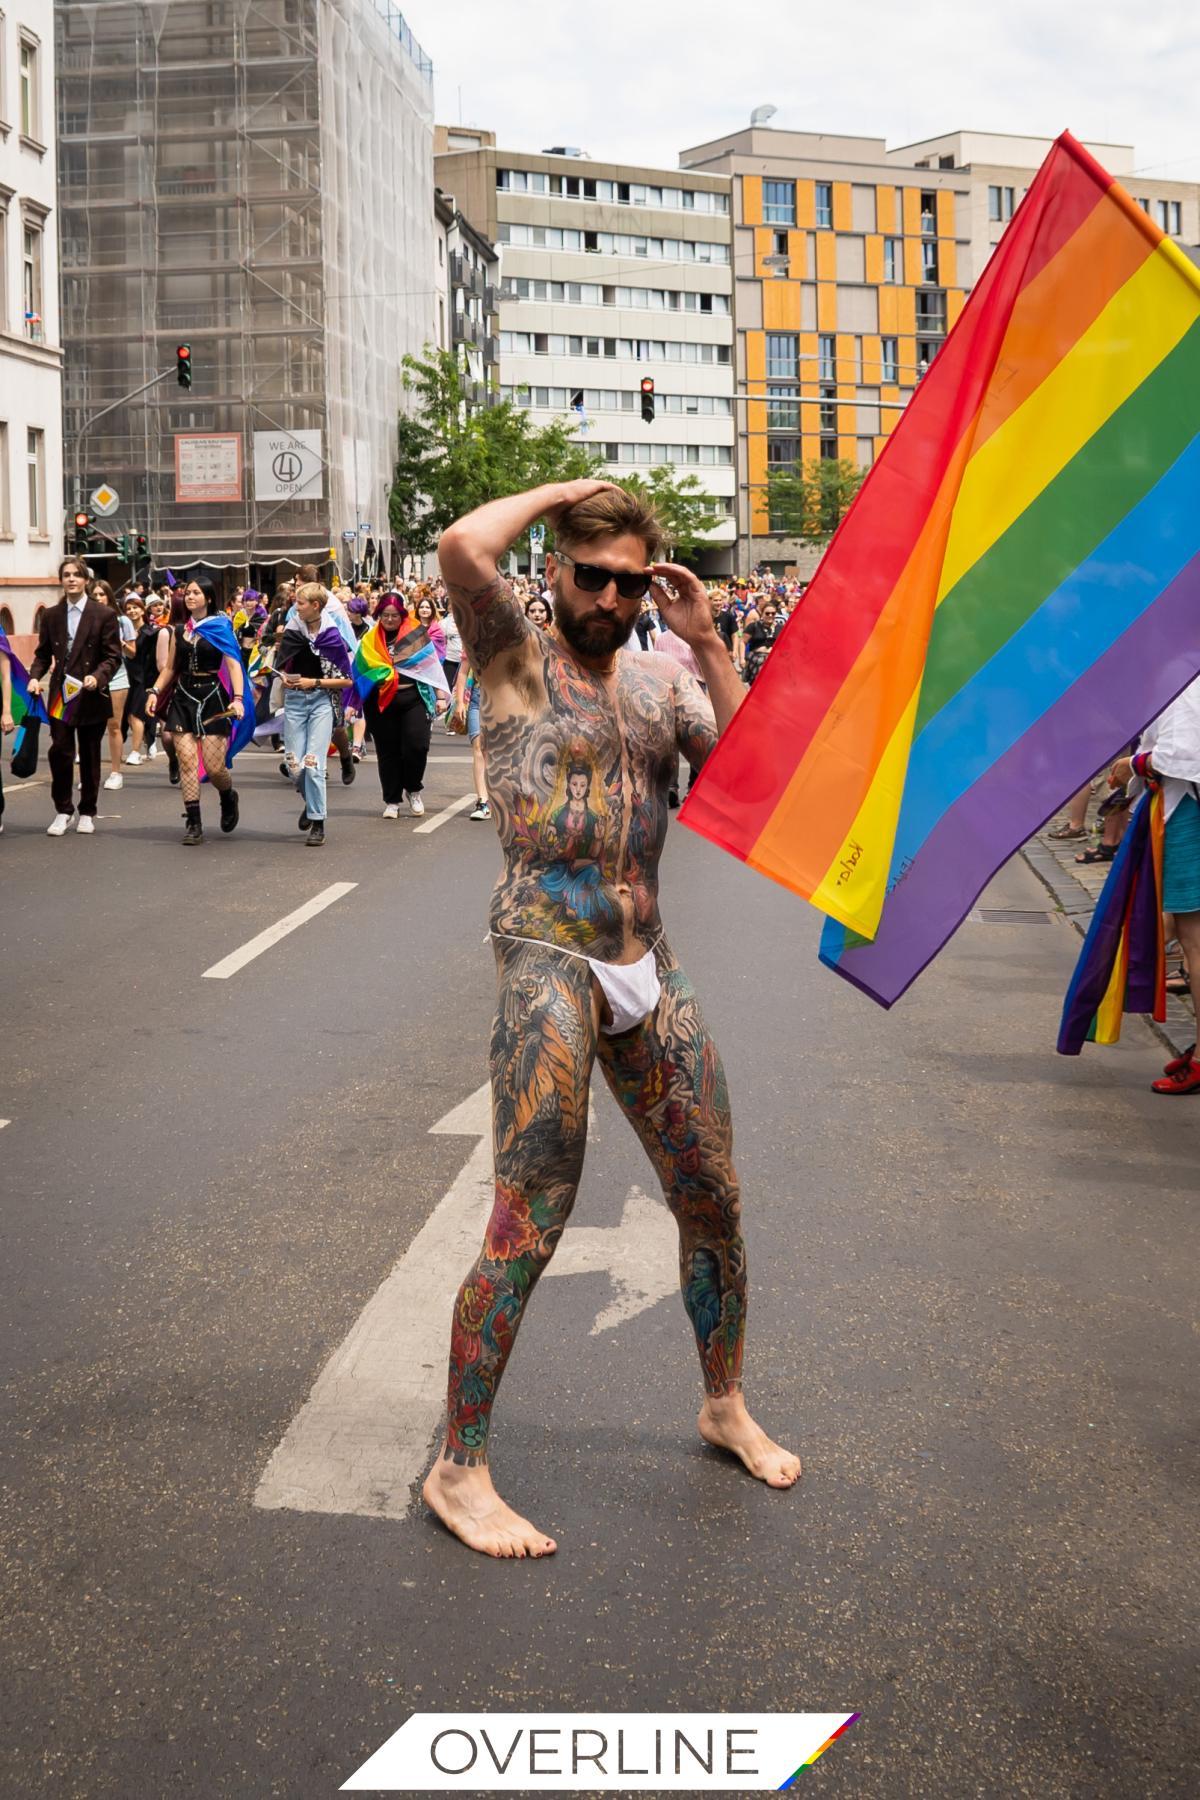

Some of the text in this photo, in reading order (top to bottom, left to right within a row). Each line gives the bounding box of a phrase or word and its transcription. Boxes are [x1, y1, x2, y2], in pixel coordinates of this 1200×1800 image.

[269, 440, 306, 450] WE ARE
[275, 484, 302, 493] OPEN
